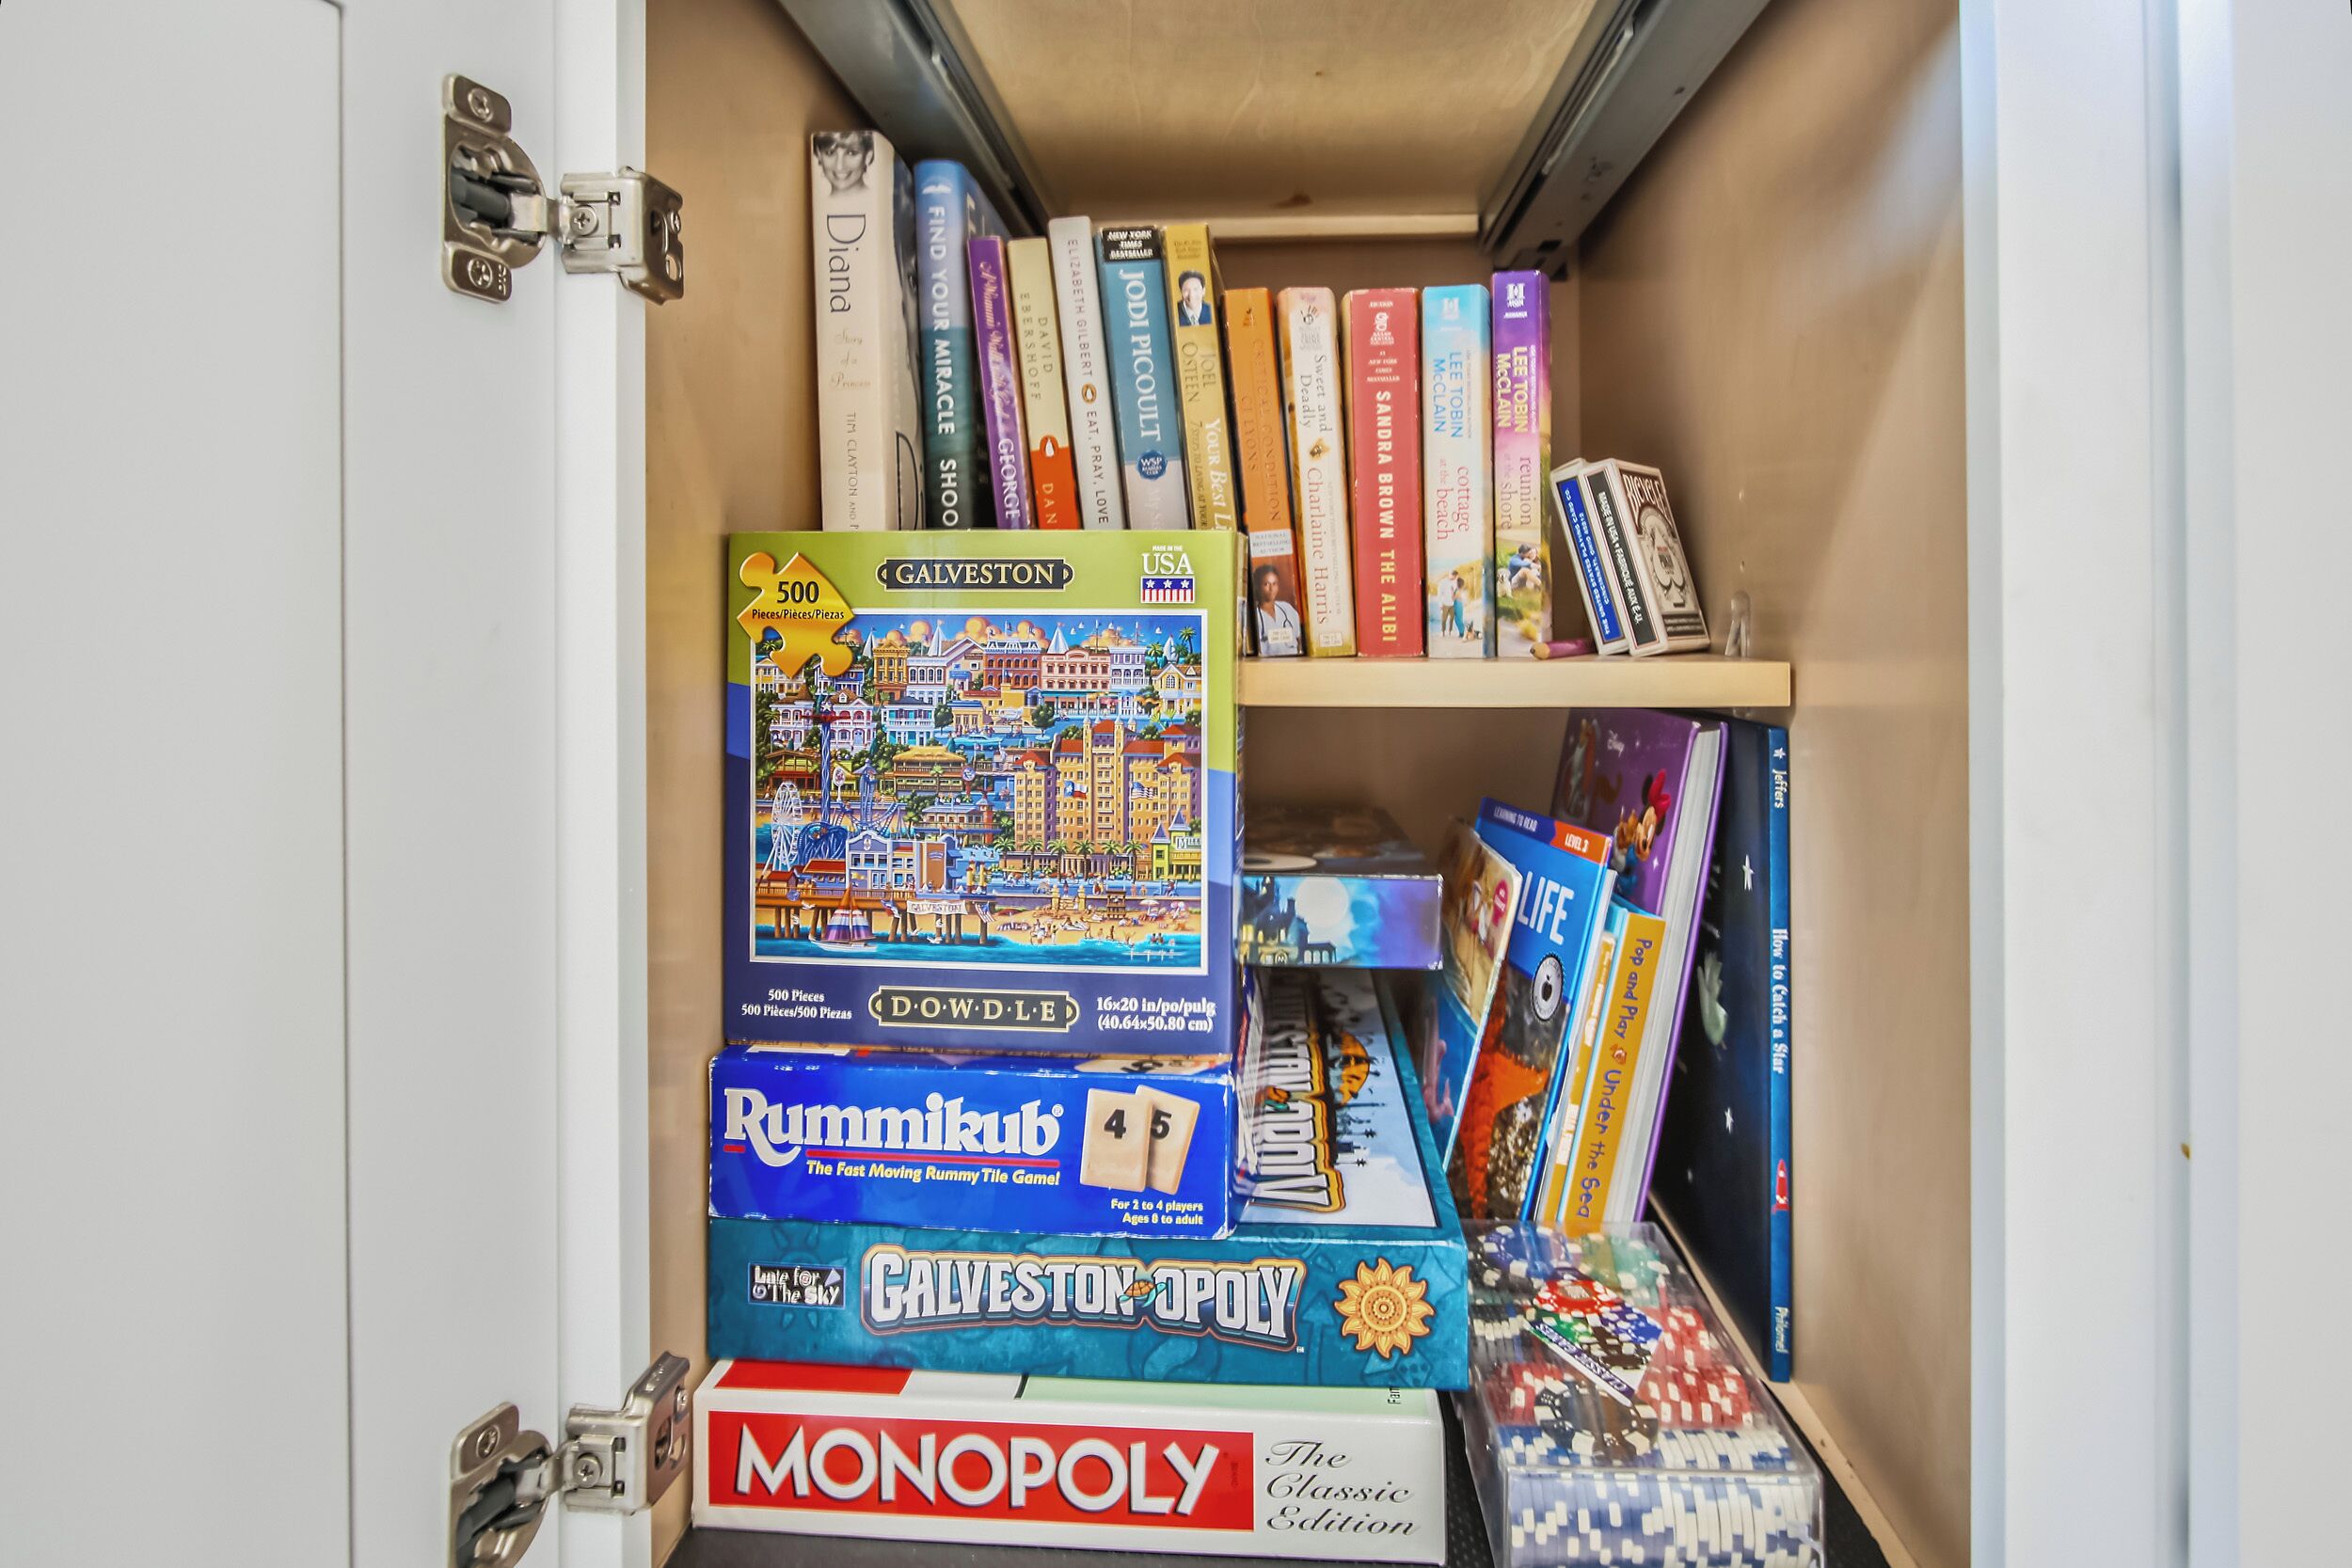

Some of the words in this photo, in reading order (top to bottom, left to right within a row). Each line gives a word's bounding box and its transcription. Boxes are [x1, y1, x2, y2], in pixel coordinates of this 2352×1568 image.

[928, 206, 947, 260] FIND
[1107, 231, 1128, 241] NEW
[1129, 230, 1152, 240] YORK
[1119, 240, 1143, 249] TIMES
[826, 214, 866, 313] Diana
[1110, 249, 1153, 260] BESTSELLER
[1066, 239, 1085, 316] ELIZABETH
[931, 269, 950, 331] YOUR
[1119, 269, 1149, 327] JODI
[1020, 293, 1041, 401] EBERSHOFF
[1038, 317, 1054, 373] DAVID
[1074, 318, 1093, 377] GILBERT
[1512, 345, 1528, 377] LEE
[1181, 341, 1200, 403] OSTEEN
[1200, 353, 1216, 388] JOEL
[1314, 355, 1327, 397] Sweet
[1449, 351, 1464, 380] LEE
[934, 340, 957, 435] MIRACLE
[1132, 334, 1161, 442] PICOULT
[1299, 374, 1316, 429] Deadly
[1433, 358, 1447, 433] McCLAIN
[1497, 353, 1512, 429] McCLAIN
[846, 412, 857, 434] TIM
[1318, 405, 1333, 433] and
[1450, 388, 1464, 437] TOBIN
[1514, 380, 1529, 433] TOBIN
[1205, 418, 1222, 466] YOUR
[1375, 389, 1393, 465] SANDRA
[1141, 456, 1163, 467] WSP
[1244, 420, 1258, 471] LYONS
[846, 439, 859, 498] CLAYTON
[998, 438, 1021, 519] GEORGE
[1262, 424, 1280, 521] CONDITION
[939, 459, 960, 527] SHOO
[1042, 483, 1057, 524] DAN
[1095, 490, 1109, 524] LOVE
[1210, 471, 1228, 508] Best
[1378, 473, 1395, 539] BROWN
[1451, 466, 1470, 531] cottage
[1500, 482, 1518, 530] shore
[1519, 456, 1536, 526] reunion
[1597, 491, 1611, 517] MADE
[1622, 473, 1674, 529] BICYCLE
[1308, 467, 1327, 560] Charlaine
[1437, 487, 1454, 541] beach
[1603, 514, 1613, 529] IN
[1574, 522, 1588, 558] PLAYING
[1607, 526, 1618, 546] USA
[896, 562, 1056, 587] GALVESTON
[1141, 552, 1195, 575] USA
[1379, 549, 1396, 585] THE
[1583, 557, 1597, 588] STATES
[776, 579, 819, 604] 500
[1314, 566, 1332, 625] Harris
[751, 607, 846, 623] Pieces/Pièces/Piezas
[1382, 593, 1397, 642] ALIBI
[1772, 768, 1788, 809] Jeffers
[1493, 806, 1518, 825] LEARNING
[1516, 814, 1524, 827] TO
[1523, 816, 1538, 832] READ
[1564, 832, 1581, 850] LEVEL
[910, 903, 961, 911] GALVESTON
[1518, 871, 1575, 946] LIFE
[1635, 938, 1653, 967] Pop
[1772, 928, 1789, 958] How
[1623, 971, 1640, 1007] and
[1772, 964, 1788, 980] to
[741, 1003, 761, 1016] 500
[763, 1004, 818, 1019] Pièces/500
[819, 1006, 852, 1020] Piezas
[768, 988, 789, 1002] 500
[791, 989, 825, 1003] Pieces
[1141, 997, 1217, 1017] in/po/pulg
[1772, 984, 1789, 1024] Catch
[1187, 1016, 1214, 1034] cm)
[1614, 1006, 1639, 1039] Play
[1772, 1028, 1784, 1038] a
[1772, 1042, 1789, 1075] Star
[1595, 1069, 1623, 1137] Under
[723, 1087, 1060, 1167] Rummikub
[1104, 1108, 1127, 1140] 4
[1150, 1109, 1172, 1140] 5
[806, 1160, 833, 1177] The
[835, 1162, 866, 1179] Fast
[867, 1164, 923, 1183] Moving
[925, 1166, 979, 1186] Rummy
[980, 1168, 1009, 1184] Tile
[1011, 1170, 1061, 1186] Game!
[1589, 1140, 1608, 1171] the
[1110, 1198, 1130, 1212] For
[1131, 1199, 1140, 1212] 2
[1142, 1199, 1154, 1212] to
[1155, 1199, 1165, 1212] 4
[1165, 1200, 1204, 1214] players
[1576, 1176, 1601, 1219] Sea
[1122, 1212, 1149, 1226] Ages
[1150, 1213, 1159, 1225] 8
[1160, 1213, 1173, 1225] to
[1174, 1213, 1204, 1226] adult
[755, 1265, 790, 1284] Late
[793, 1265, 821, 1287] for
[870, 1252, 1136, 1322] GALVESTON
[768, 1283, 803, 1304] The
[804, 1284, 840, 1307] Sky
[1774, 1306, 1789, 1354] Philomel
[734, 1421, 1220, 1516] MONOPOLY
[1263, 1438, 1348, 1471] The
[1263, 1472, 1414, 1506] Classic
[1264, 1505, 1419, 1537] Edition
